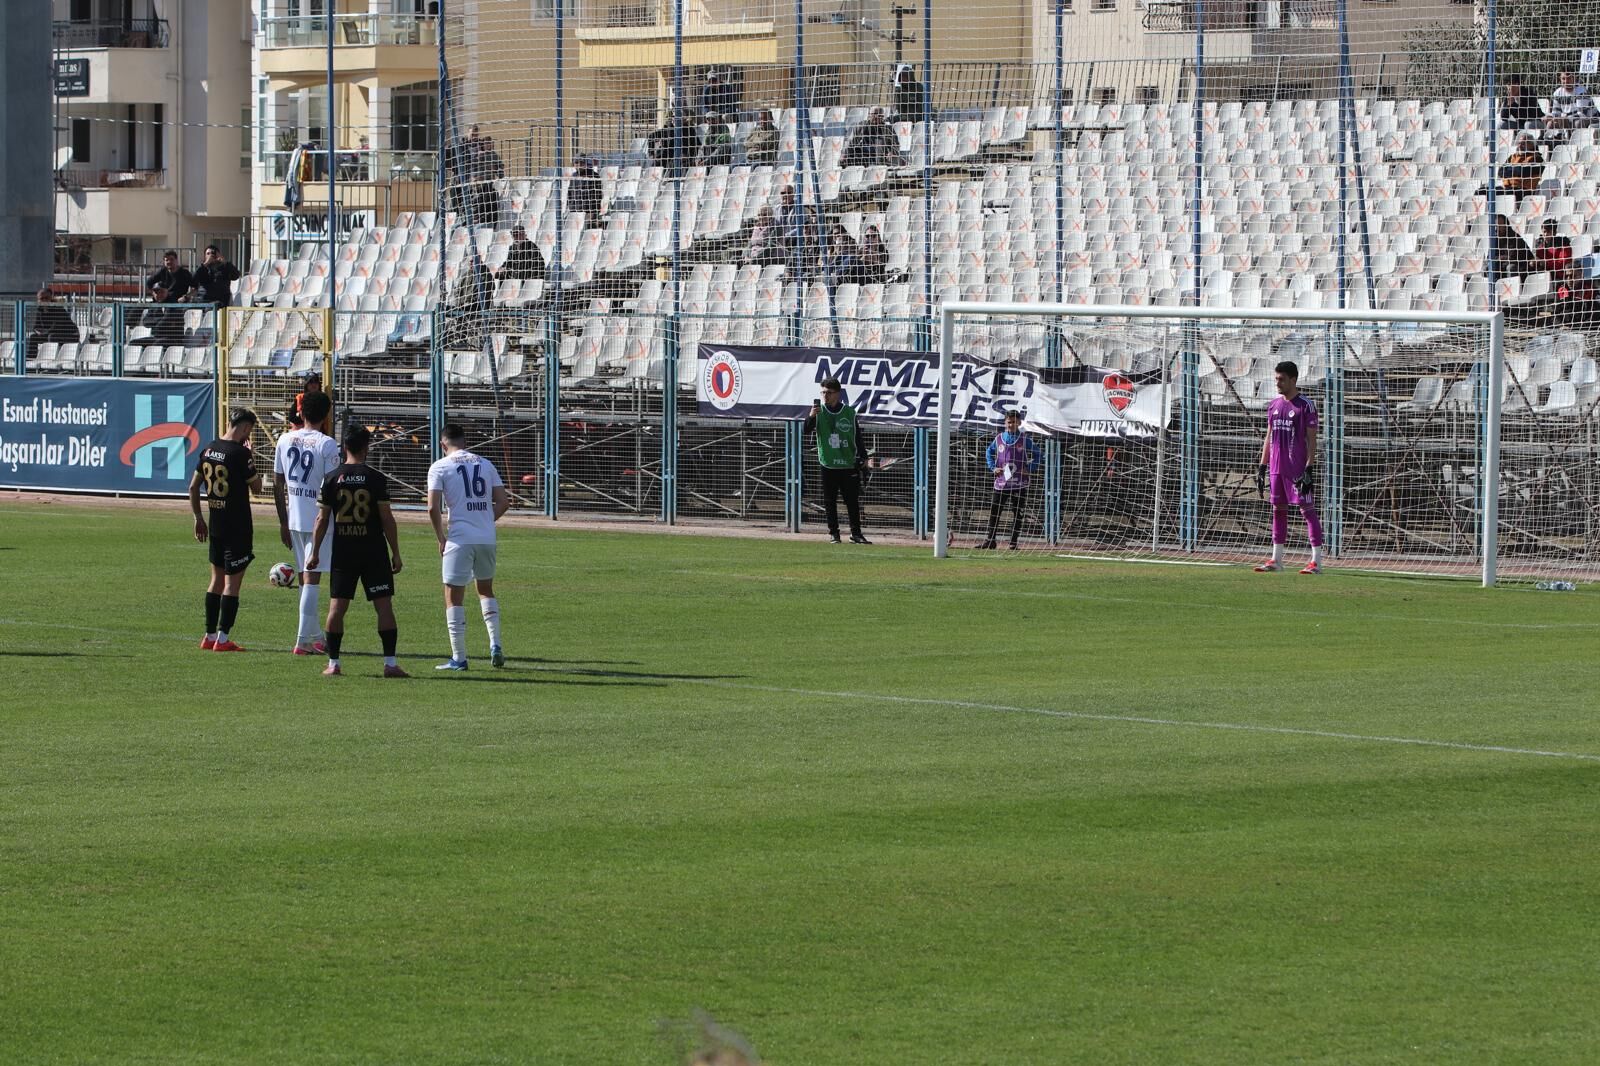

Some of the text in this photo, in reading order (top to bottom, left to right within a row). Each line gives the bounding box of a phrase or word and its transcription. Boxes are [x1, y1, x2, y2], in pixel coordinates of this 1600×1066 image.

[1586, 51, 1594, 63] B
[3, 397, 107, 426] Esnaf Hastanesi
[0, 433, 106, 472] aşarılar Diler
[209, 452, 226, 460] AKSU
[286, 446, 314, 484] 29
[456, 464, 486, 498] 16
[336, 488, 371, 523] 28
[339, 525, 368, 536] H.KAYA
